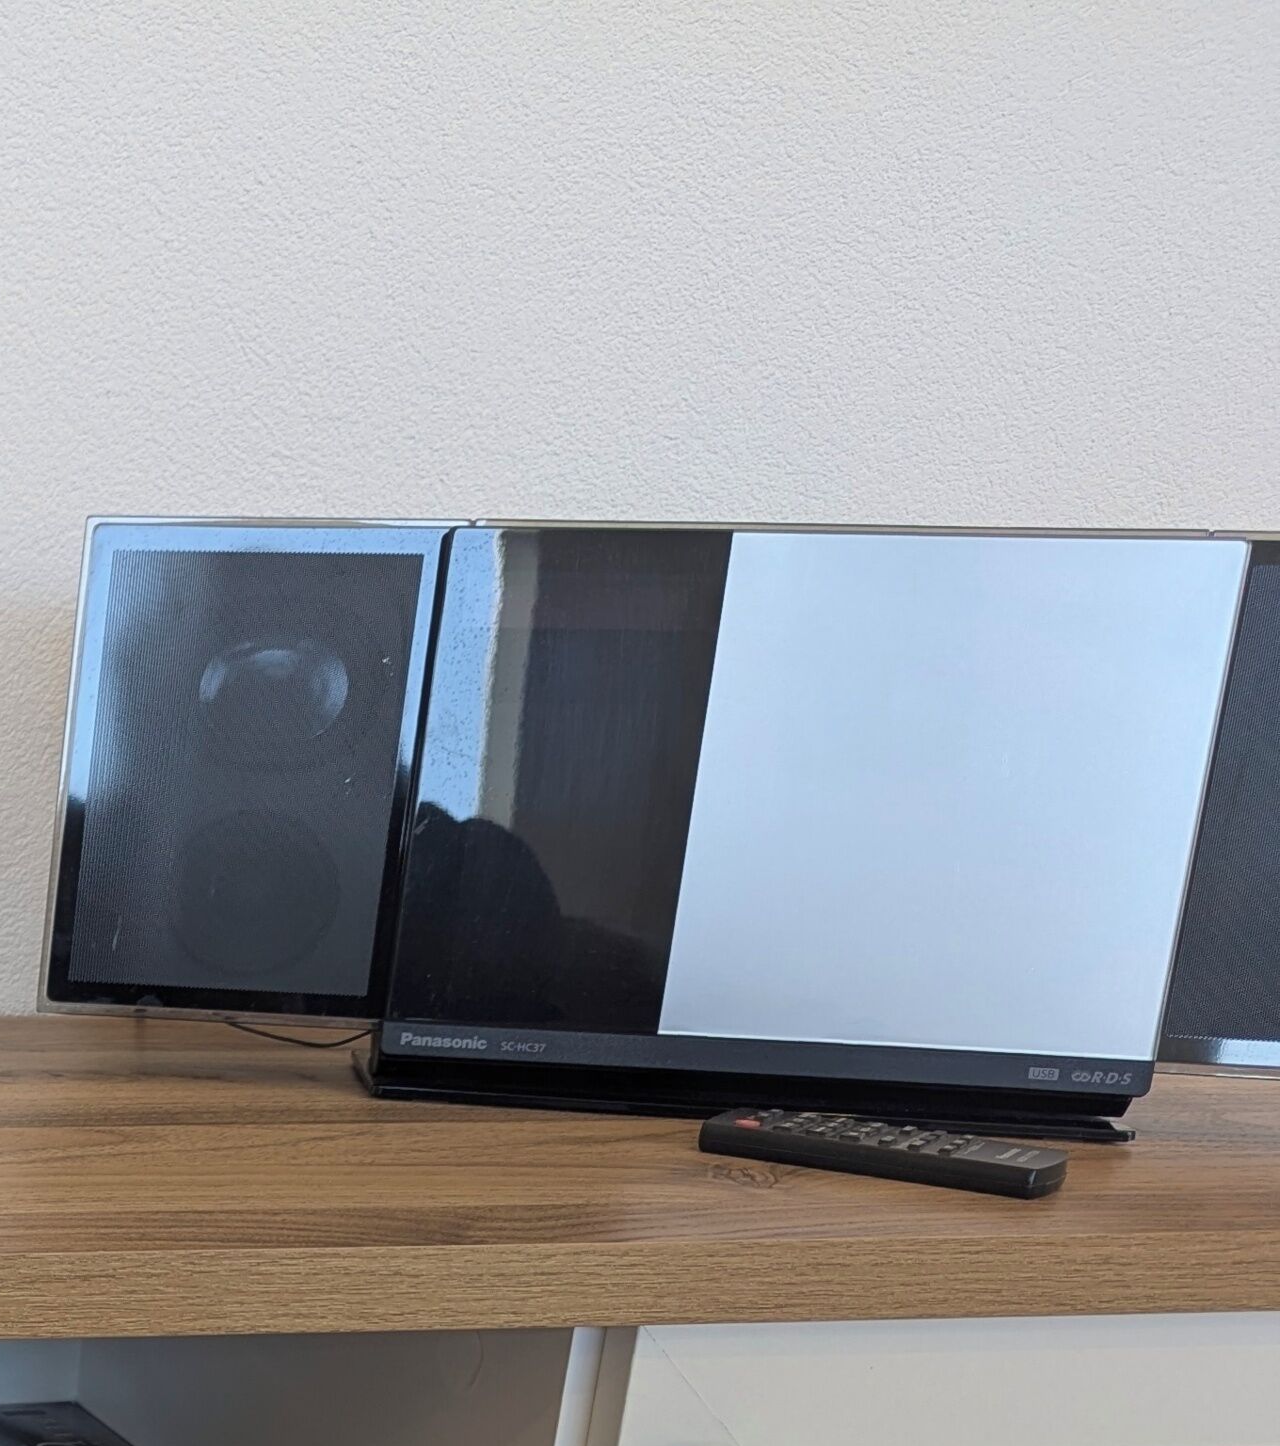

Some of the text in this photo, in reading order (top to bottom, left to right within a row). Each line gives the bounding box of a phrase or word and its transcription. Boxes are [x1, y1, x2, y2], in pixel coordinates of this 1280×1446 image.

[399, 1031, 546, 1053] Panasonic SC-HC37
[1031, 1068, 1056, 1080] USB
